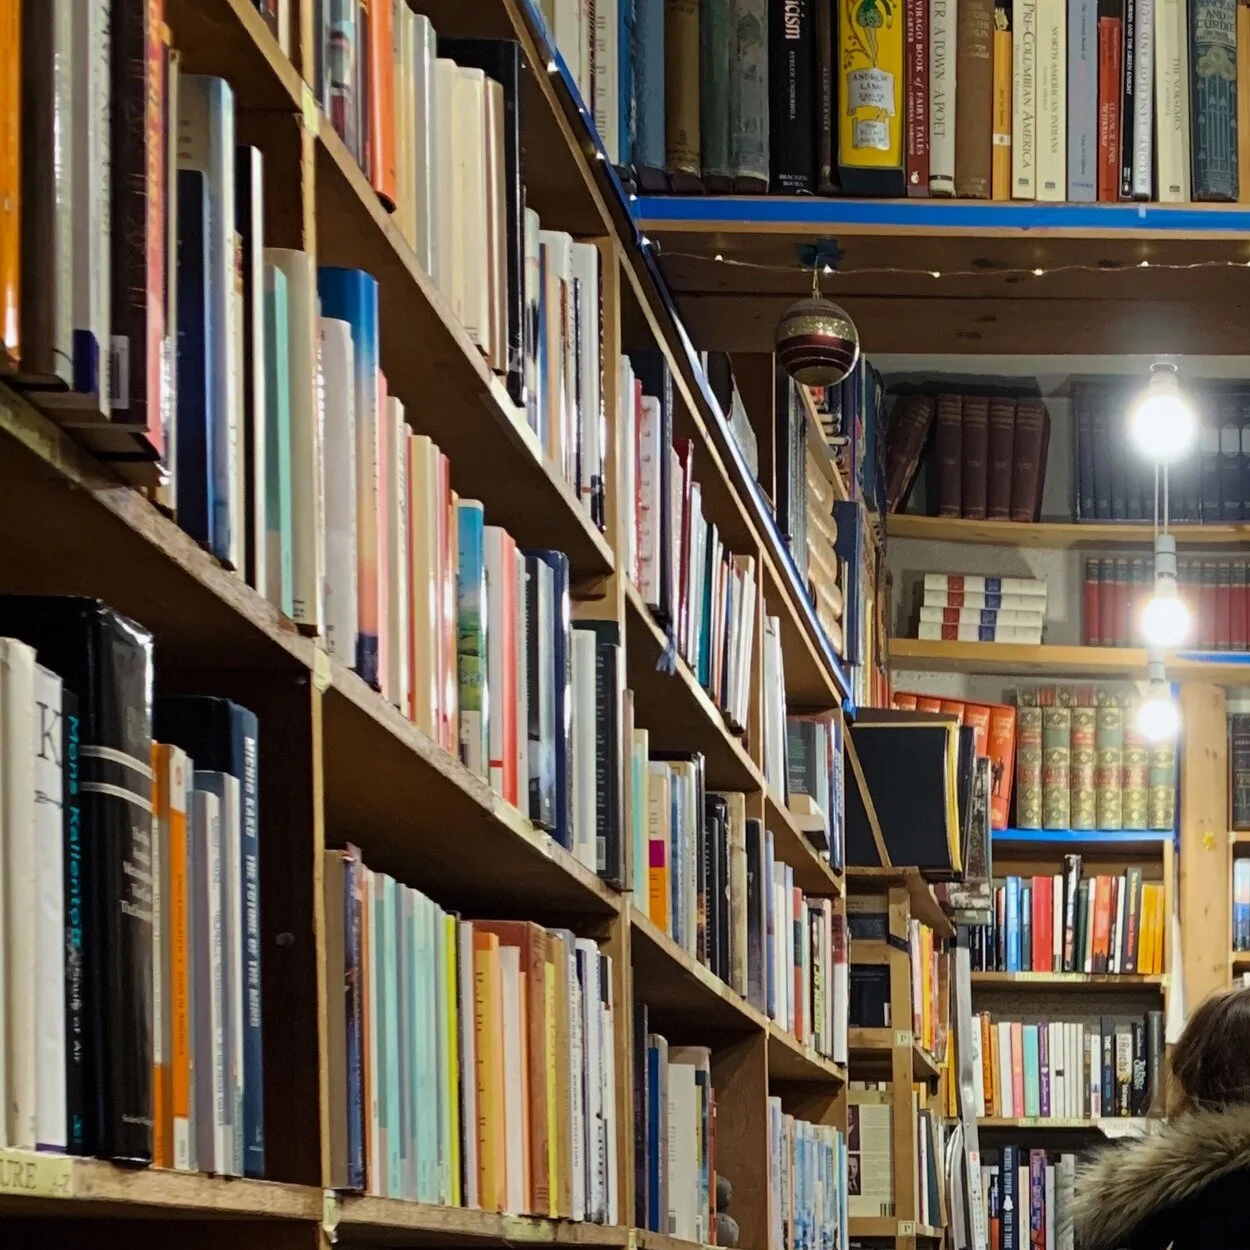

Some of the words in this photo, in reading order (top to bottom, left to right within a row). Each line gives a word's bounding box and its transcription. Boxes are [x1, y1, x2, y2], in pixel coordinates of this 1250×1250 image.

[915, 1, 925, 40] VIRAGO
[915, 43, 925, 73] BOOK
[1022, 2, 1036, 107] PRE-COLUMBIAN
[1051, 26, 1059, 60] NORTH
[1140, 31, 1149, 53] AND
[914, 77, 925, 88] of
[1051, 63, 1059, 113] AMERICAN
[915, 92, 925, 122] FAIRY
[915, 125, 926, 155] TALES
[1022, 112, 1036, 168] AMERICA
[1051, 115, 1059, 154] INDIANS
[69, 716, 80, 796] Mons
[244, 736, 257, 794] MICHIO
[245, 796, 257, 838] KAKU
[246, 854, 258, 878] THE
[246, 882, 259, 936] FUTURE
[247, 939, 259, 957] OF
[248, 959, 260, 985] THE
[248, 987, 261, 1028] MIND
